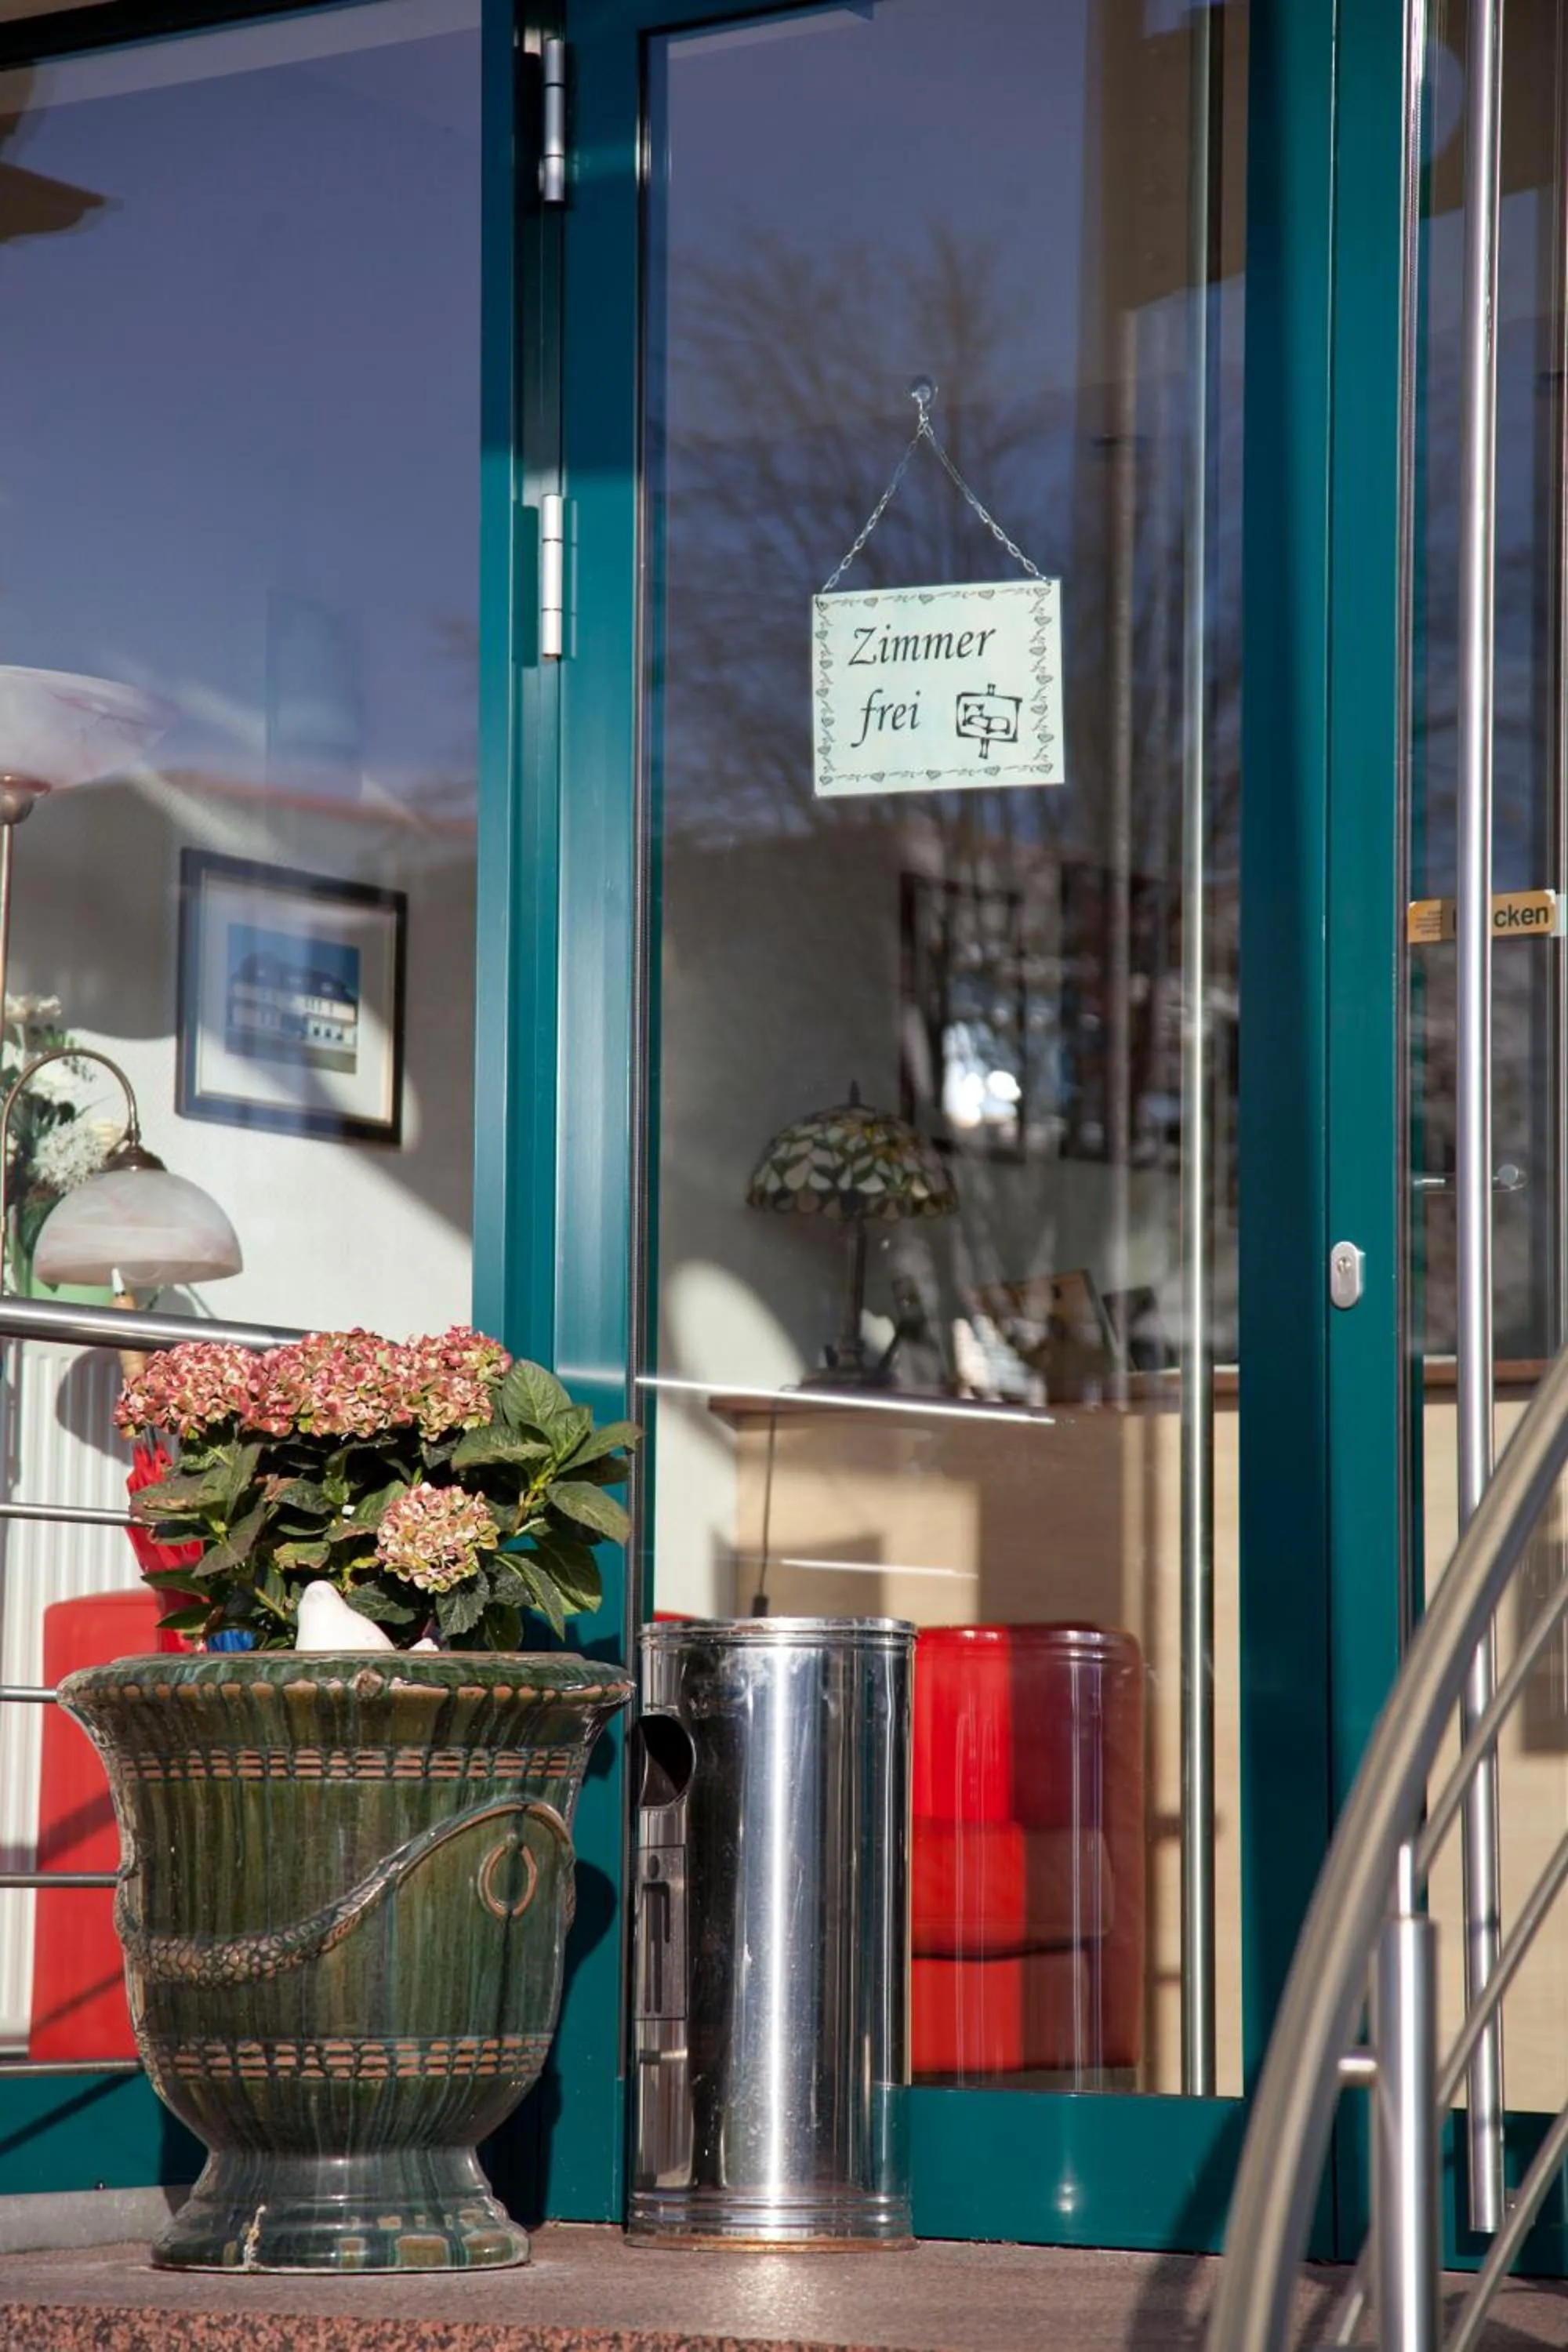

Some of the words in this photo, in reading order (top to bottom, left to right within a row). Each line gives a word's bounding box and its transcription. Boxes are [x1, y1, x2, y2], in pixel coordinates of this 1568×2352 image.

[848, 624, 996, 666] Zimmer
[851, 688, 920, 747] frei
[1453, 904, 1548, 932] cken
